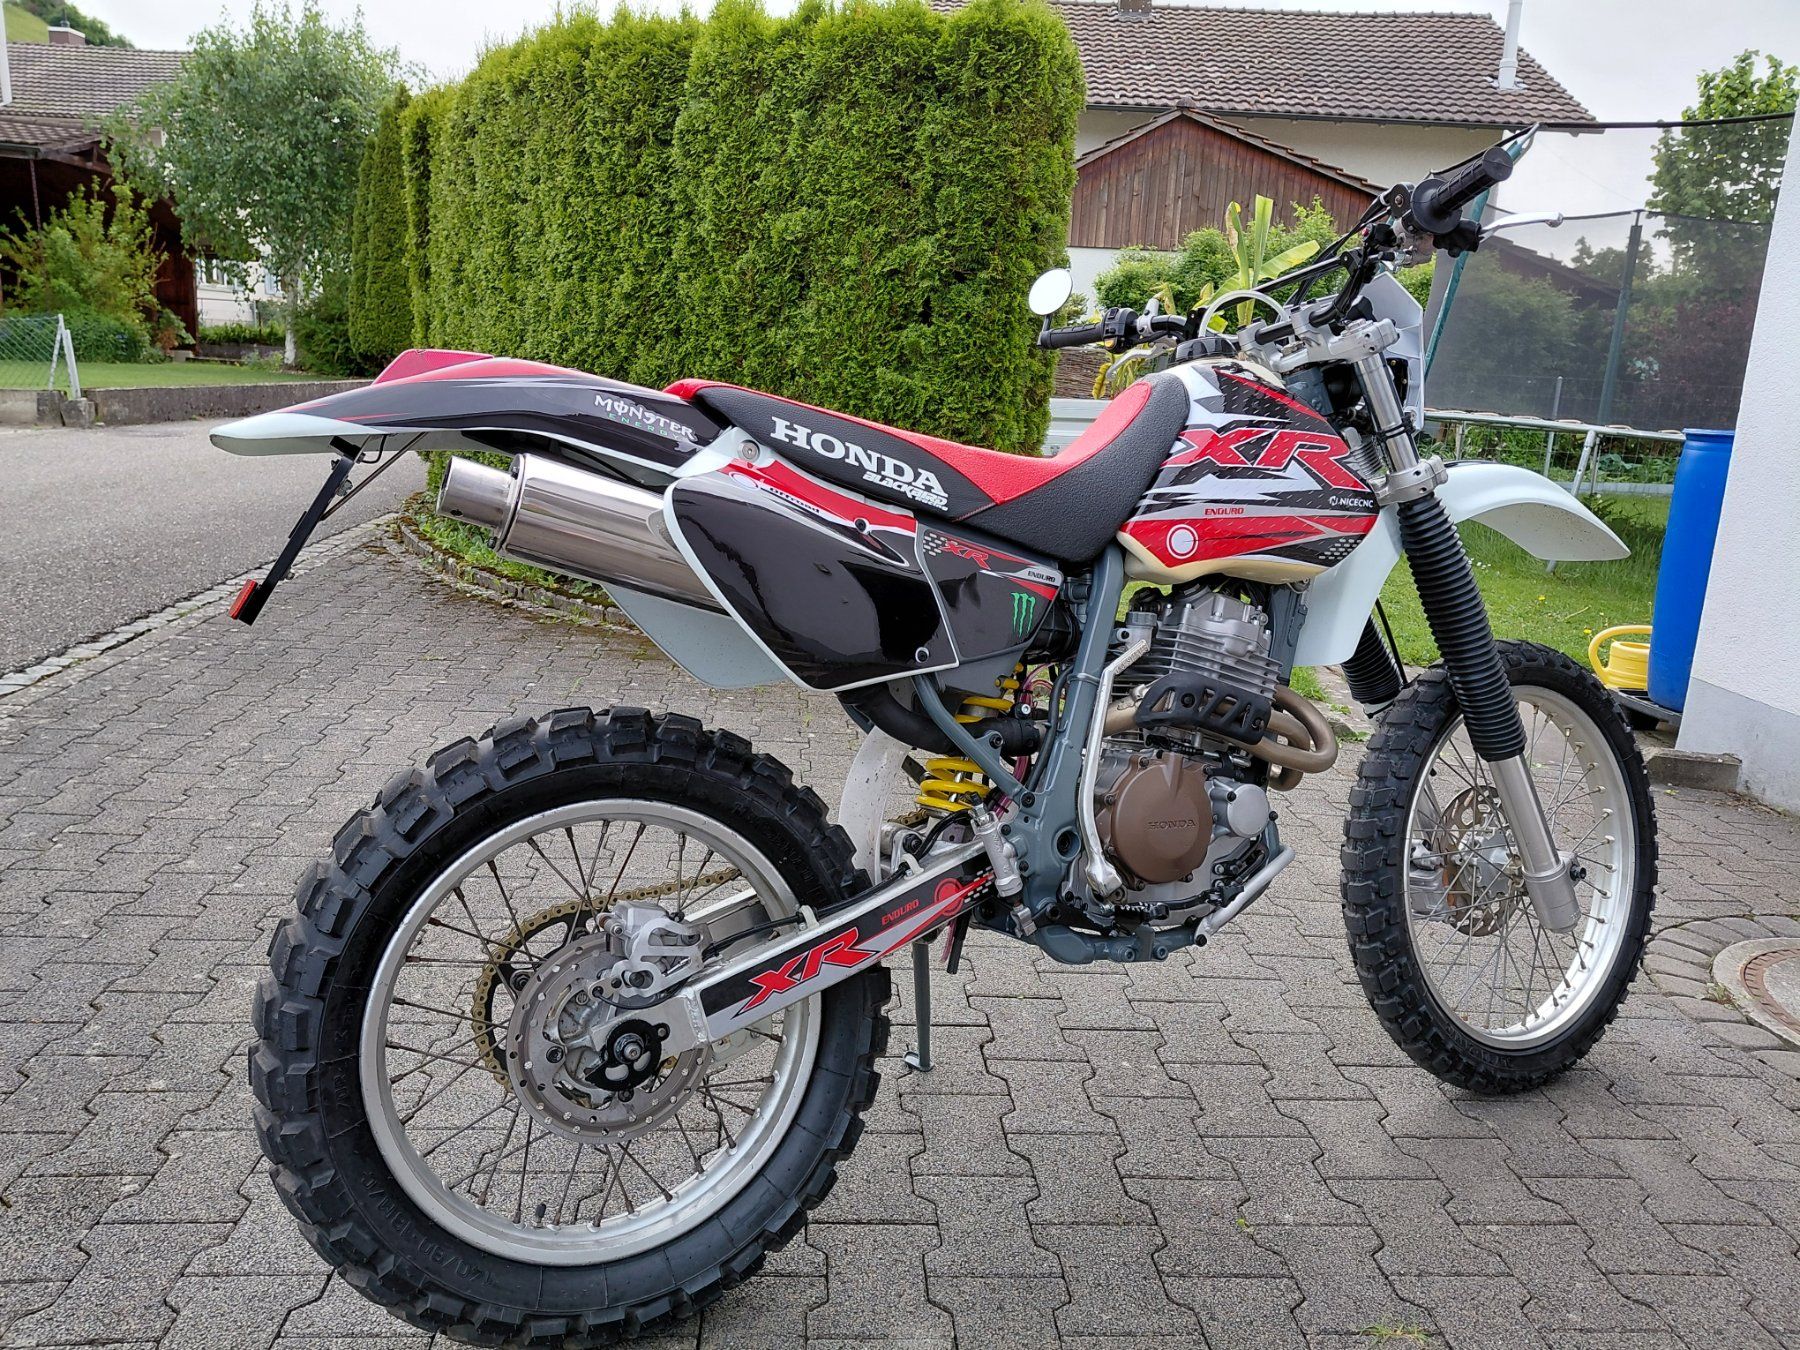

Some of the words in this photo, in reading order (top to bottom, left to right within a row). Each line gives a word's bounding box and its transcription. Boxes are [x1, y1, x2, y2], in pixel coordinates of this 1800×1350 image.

[608, 412, 679, 441] ENERGY
[770, 416, 949, 499] HONDA
[1159, 427, 1371, 492] XR
[1204, 507, 1244, 516] ENDURO
[1339, 498, 1374, 509] NICECNC
[939, 541, 991, 571] XR
[1027, 570, 1056, 583] ENDURO
[1147, 817, 1197, 831] HONDA
[881, 899, 920, 926] ENDURO
[733, 926, 879, 1017] XR
